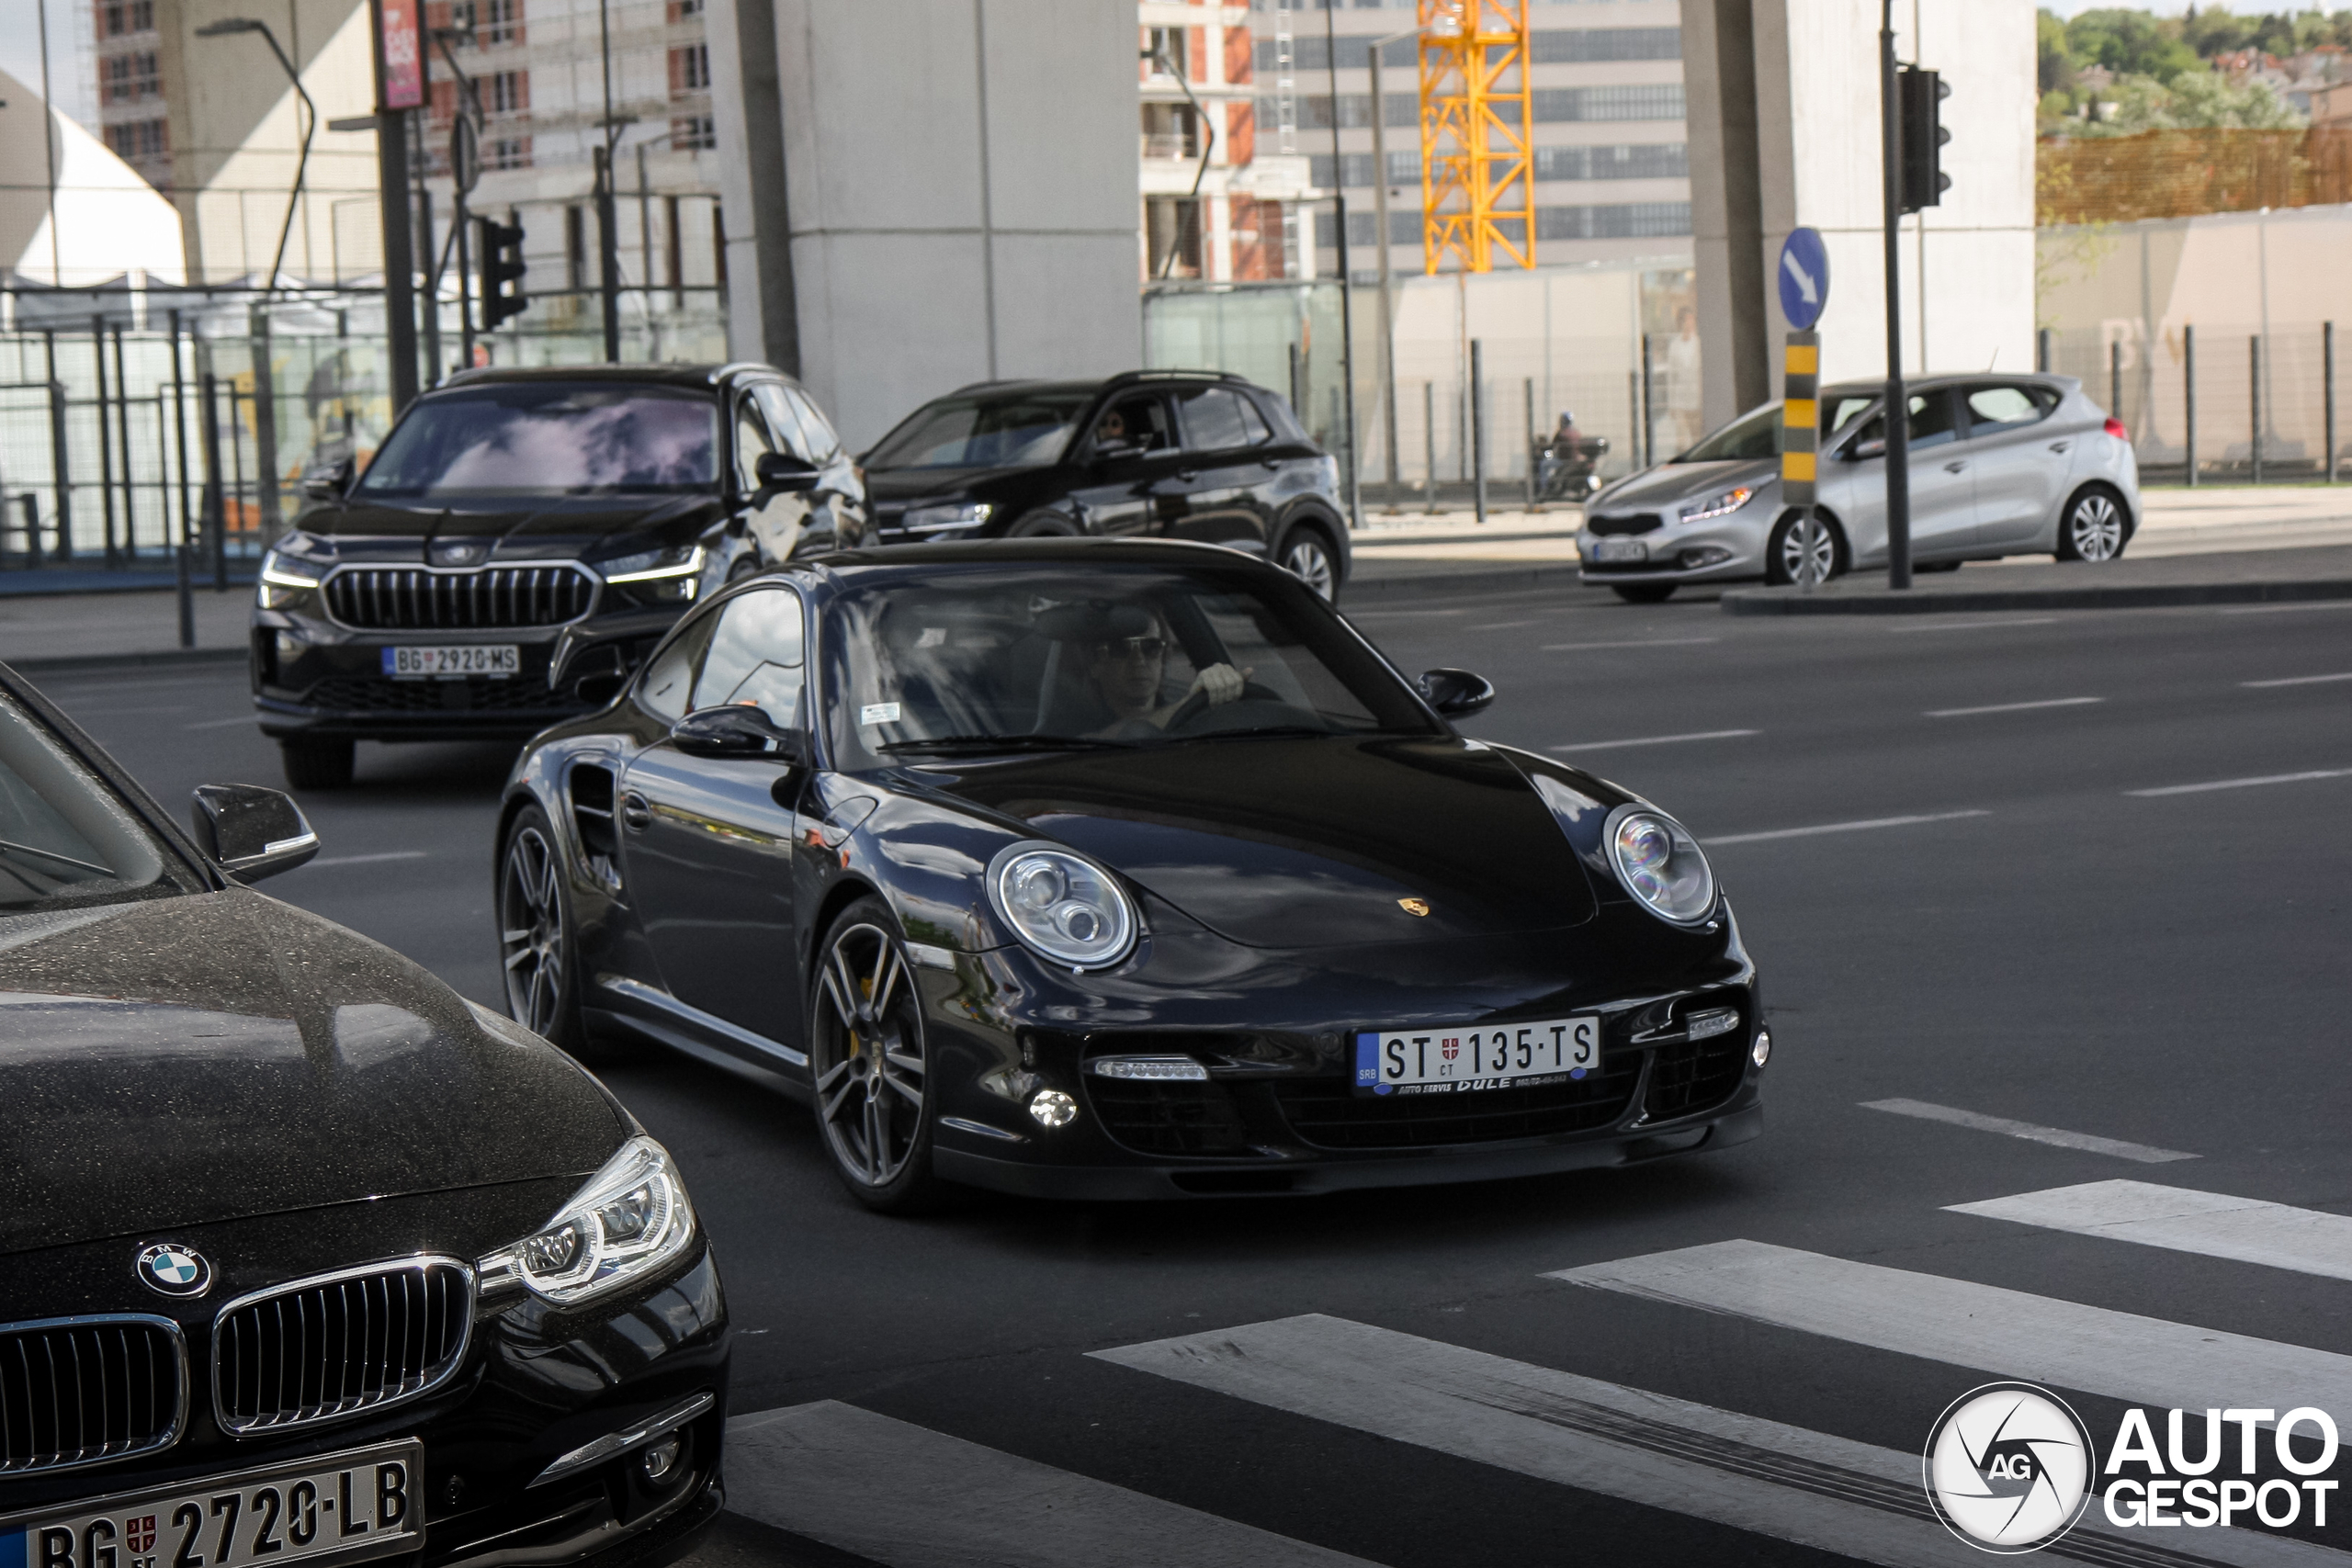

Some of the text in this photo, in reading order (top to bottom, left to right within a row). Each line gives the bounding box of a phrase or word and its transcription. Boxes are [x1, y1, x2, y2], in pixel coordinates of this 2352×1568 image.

[398, 648, 515, 671] BG 2920-MS
[1385, 1023, 1591, 1079] ST 135-TS
[1359, 1068, 1377, 1079] SRB
[1397, 1085, 1422, 1095] AUTO
[1422, 1083, 1452, 1093] SERVIS
[1456, 1077, 1511, 1092] DULE
[141, 1245, 197, 1264] BMW
[40, 1461, 407, 1568] BG 2720-LB
